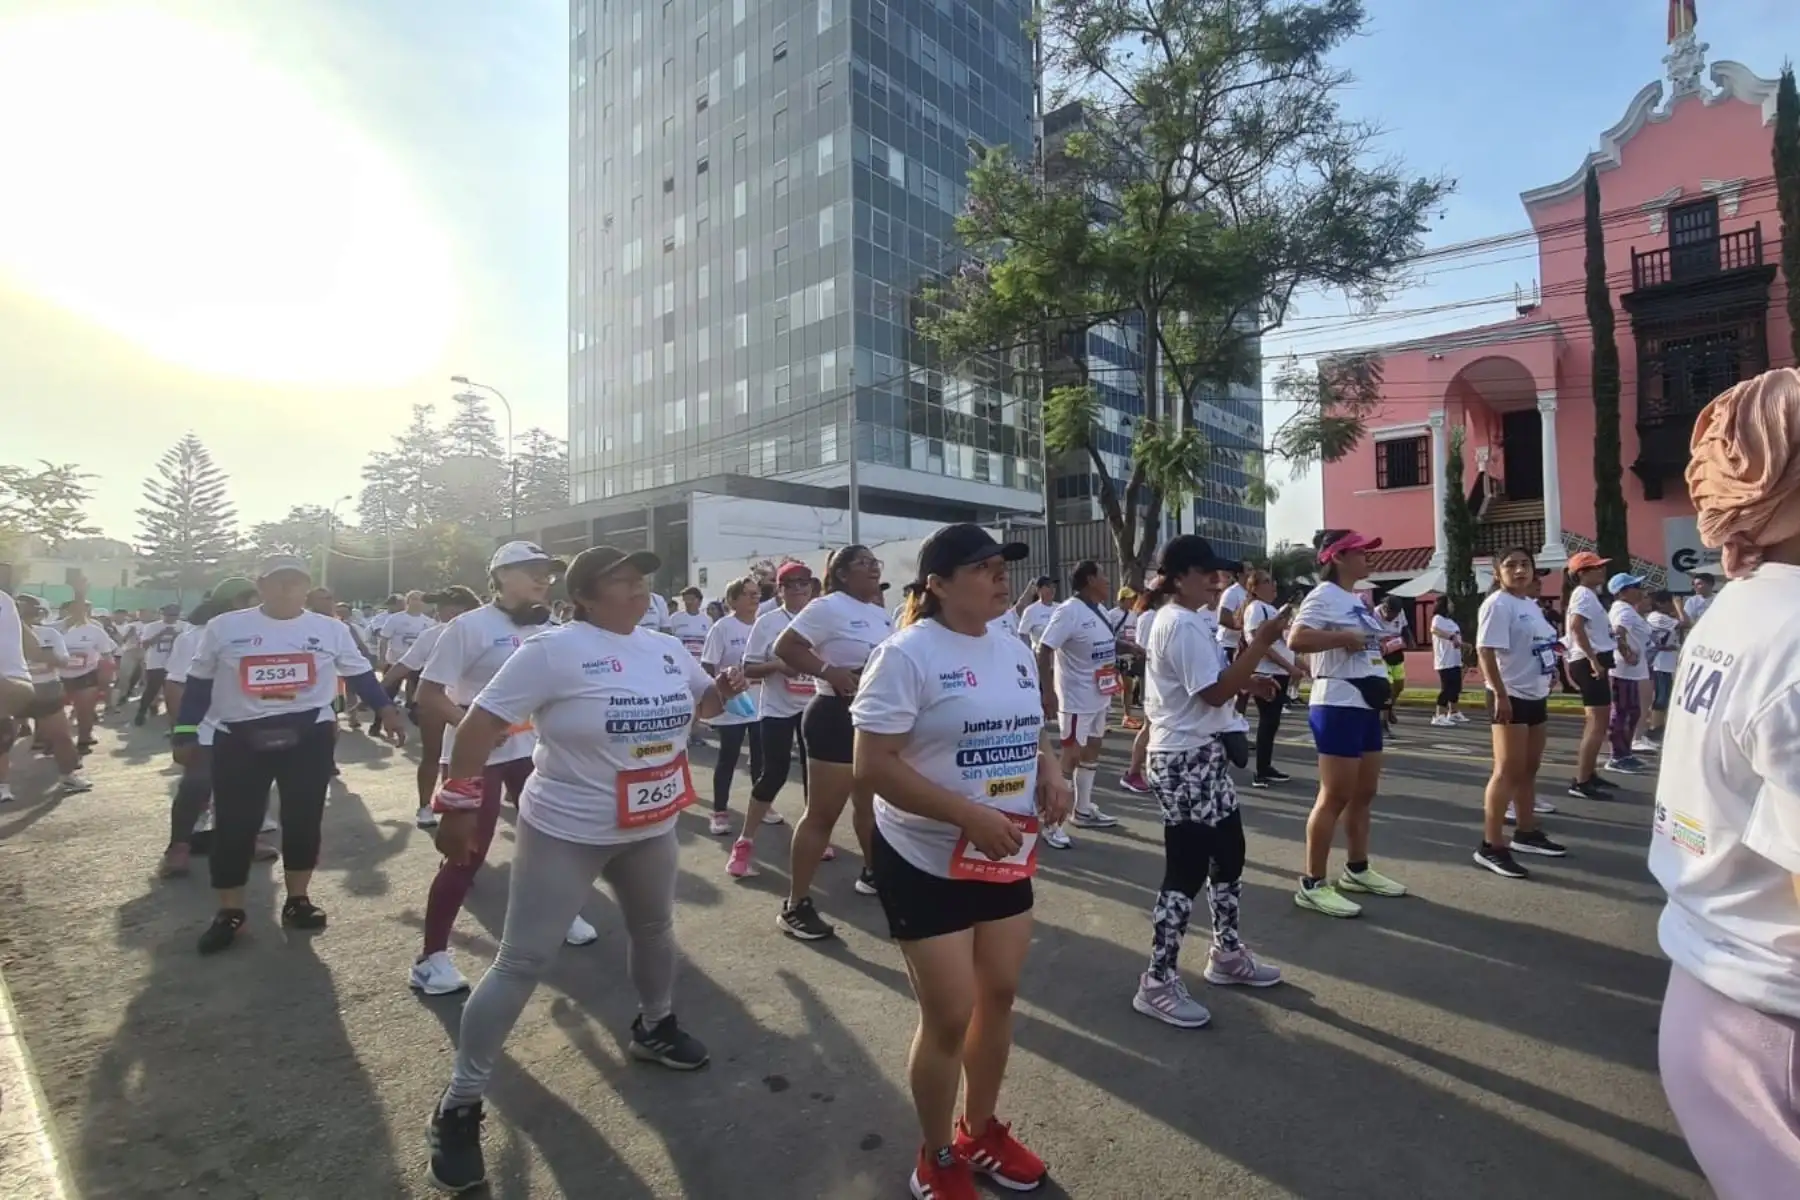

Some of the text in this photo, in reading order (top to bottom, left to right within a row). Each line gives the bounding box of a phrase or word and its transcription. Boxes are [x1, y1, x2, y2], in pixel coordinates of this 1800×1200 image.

[255, 667, 296, 681] 2534
[609, 695, 650, 706] Juntas
[652, 696, 660, 707] y
[612, 722, 631, 732] LA
[963, 719, 1003, 734] Juntas
[1005, 719, 1013, 732] y
[958, 732, 1022, 748] caminando
[963, 751, 983, 765] LA
[961, 766, 983, 780] sin
